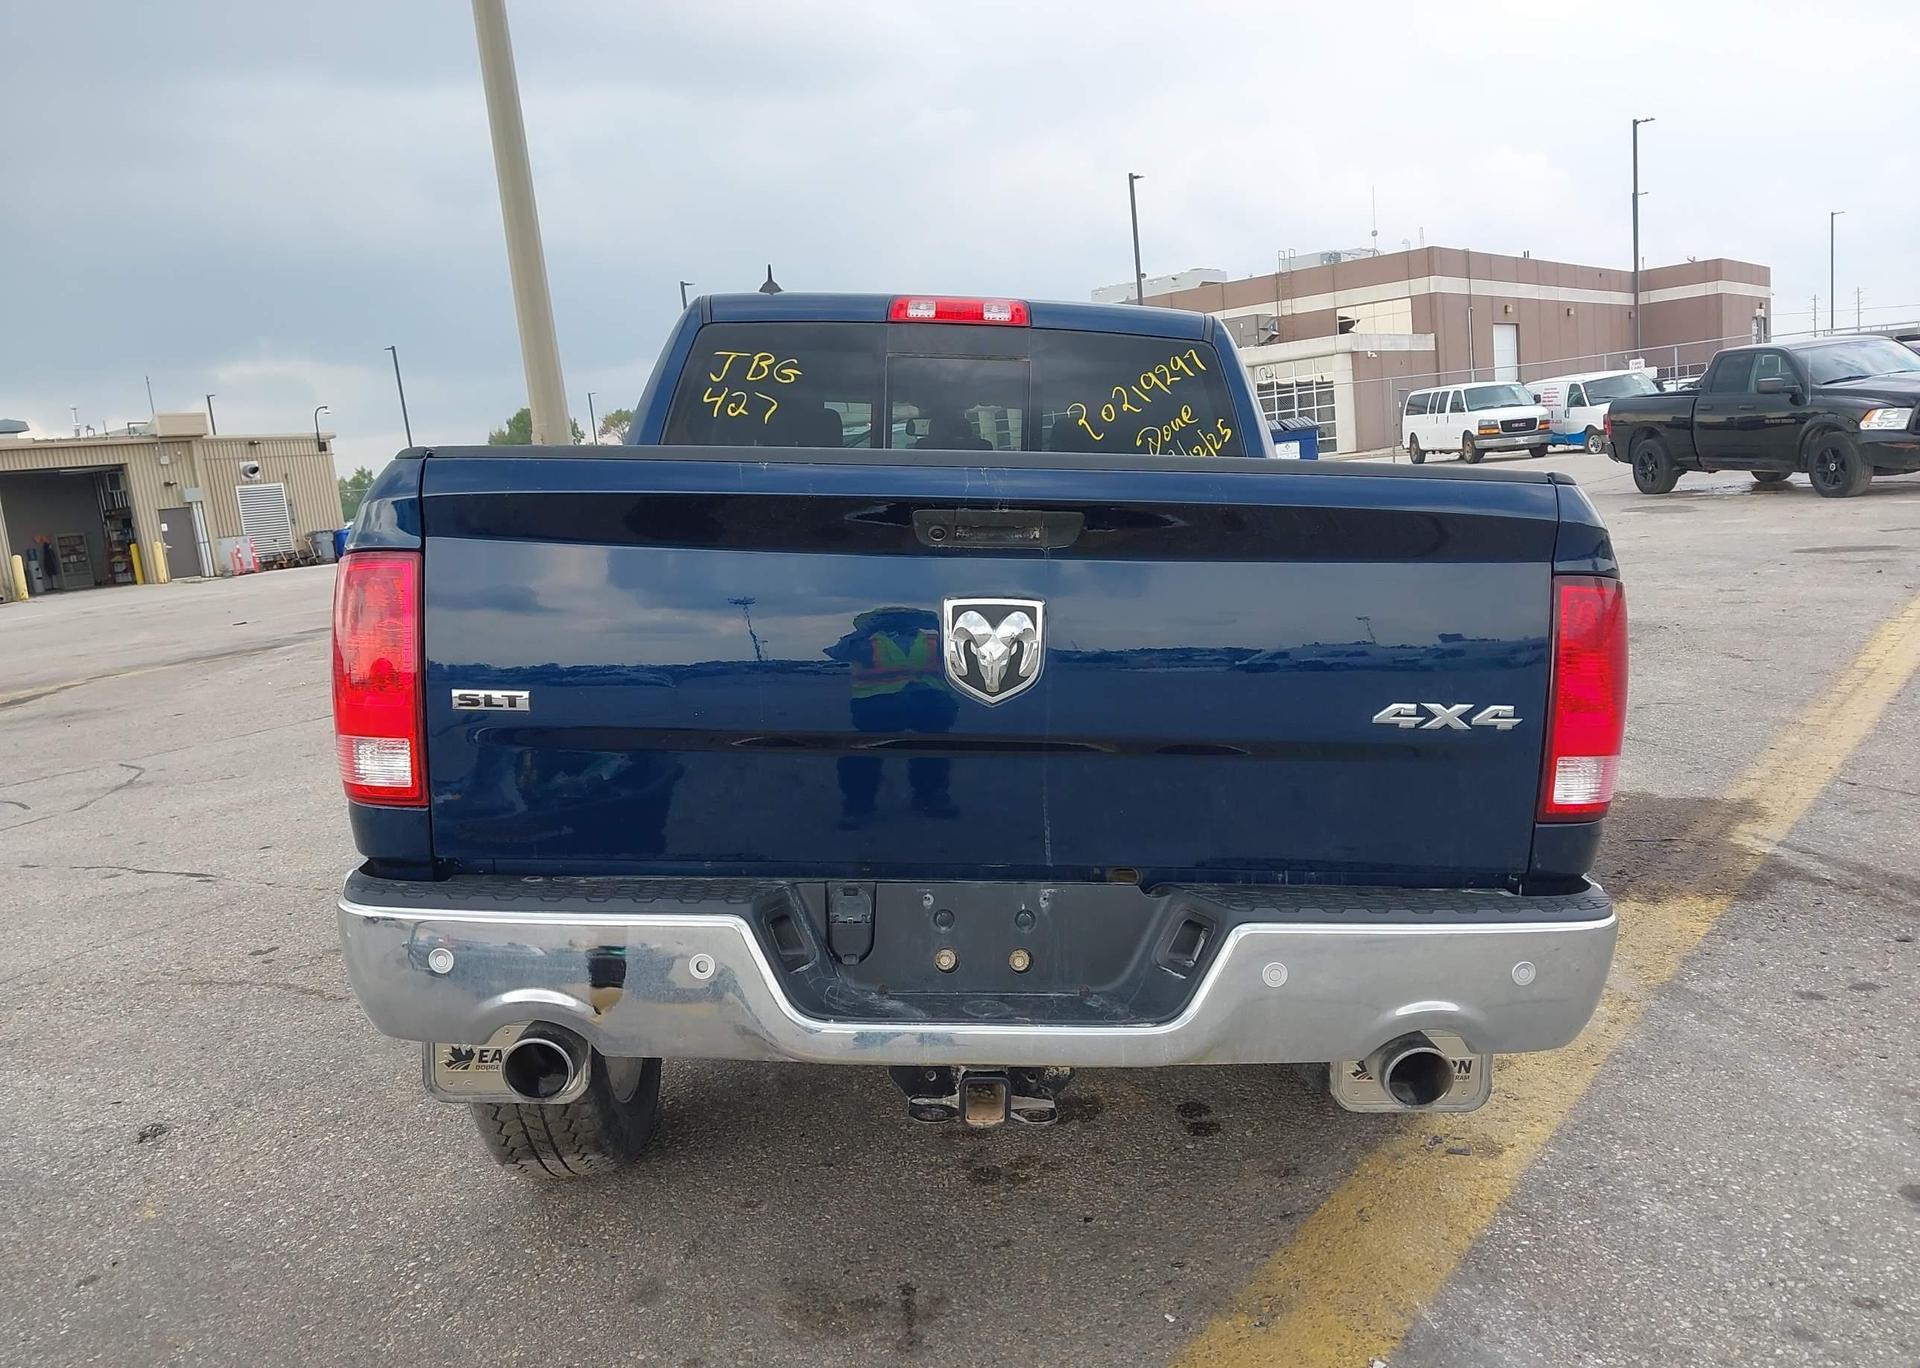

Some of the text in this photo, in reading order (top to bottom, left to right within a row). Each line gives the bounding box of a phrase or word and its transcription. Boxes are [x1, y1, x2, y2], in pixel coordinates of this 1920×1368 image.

[703, 387, 778, 425] 427
[1066, 348, 1208, 441] 20219297
[1135, 404, 1200, 457] Done
[457, 693, 525, 708] SLT
[1371, 702, 1525, 731] 4X4
